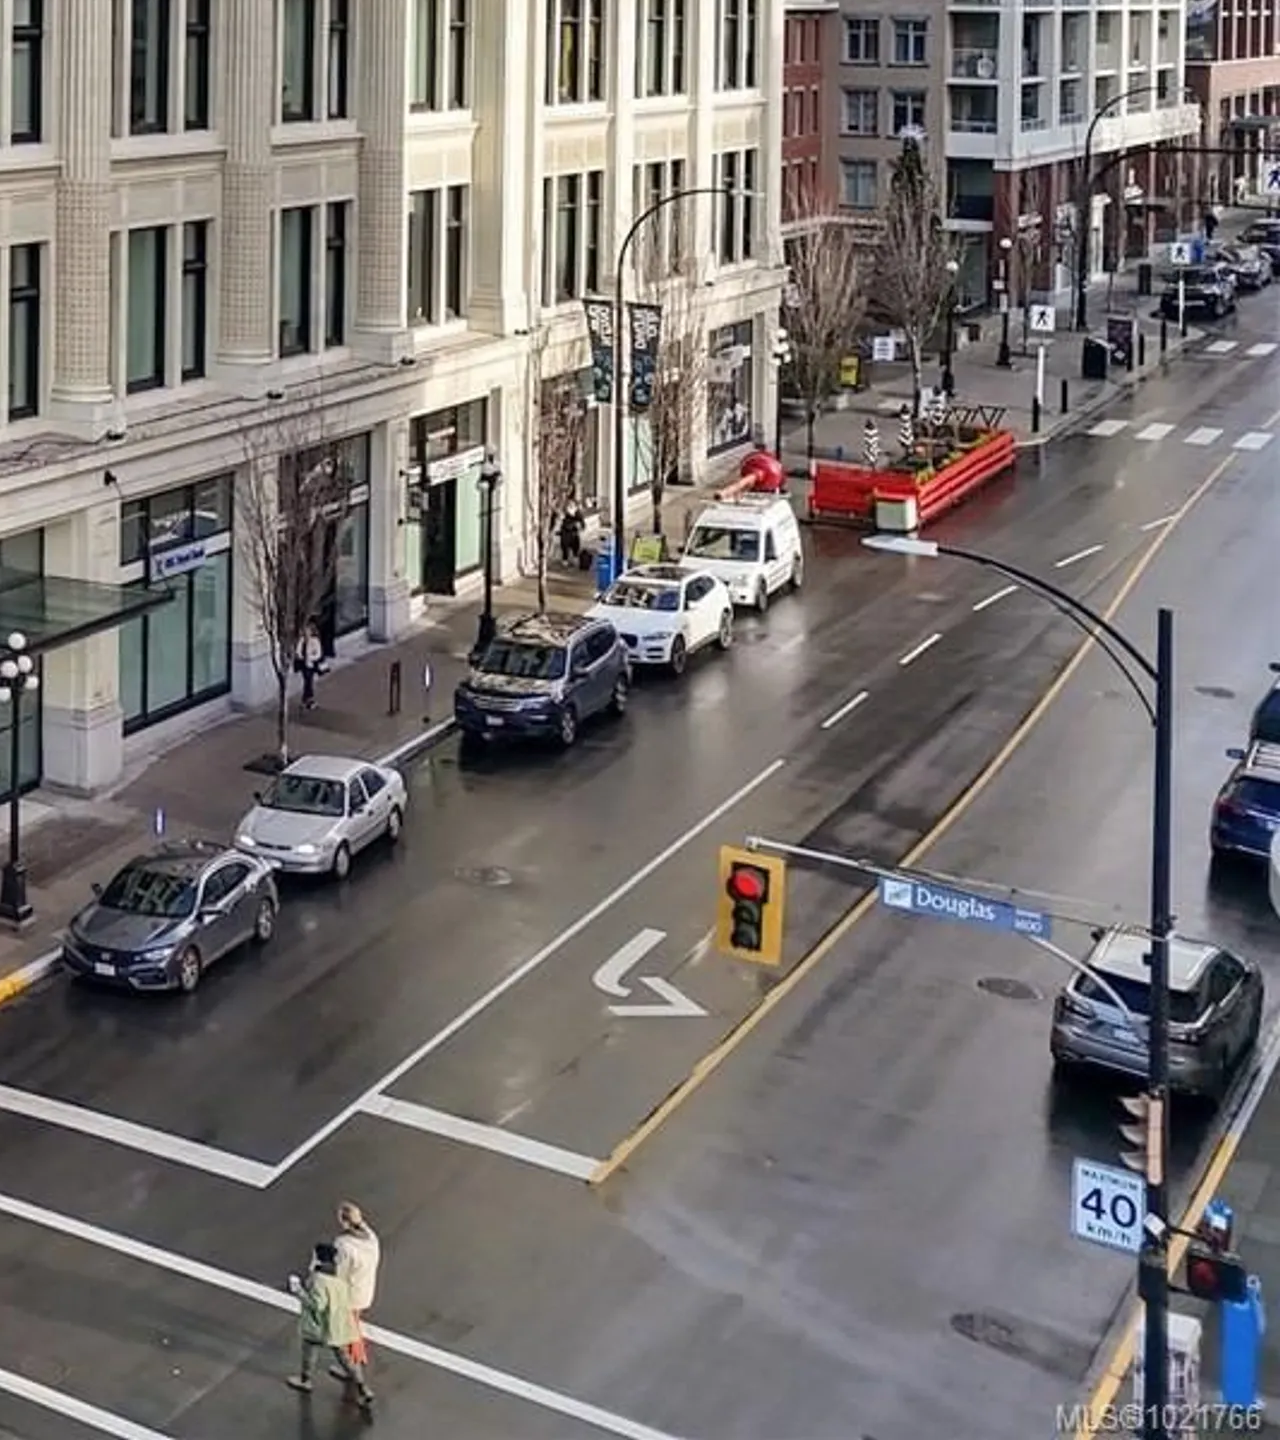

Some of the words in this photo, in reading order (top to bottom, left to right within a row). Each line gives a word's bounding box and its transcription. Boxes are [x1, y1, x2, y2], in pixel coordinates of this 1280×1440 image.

[916, 885, 996, 922] Douglas
[1080, 1187, 1137, 1229] 40
[1086, 1221, 1131, 1245] km/h
